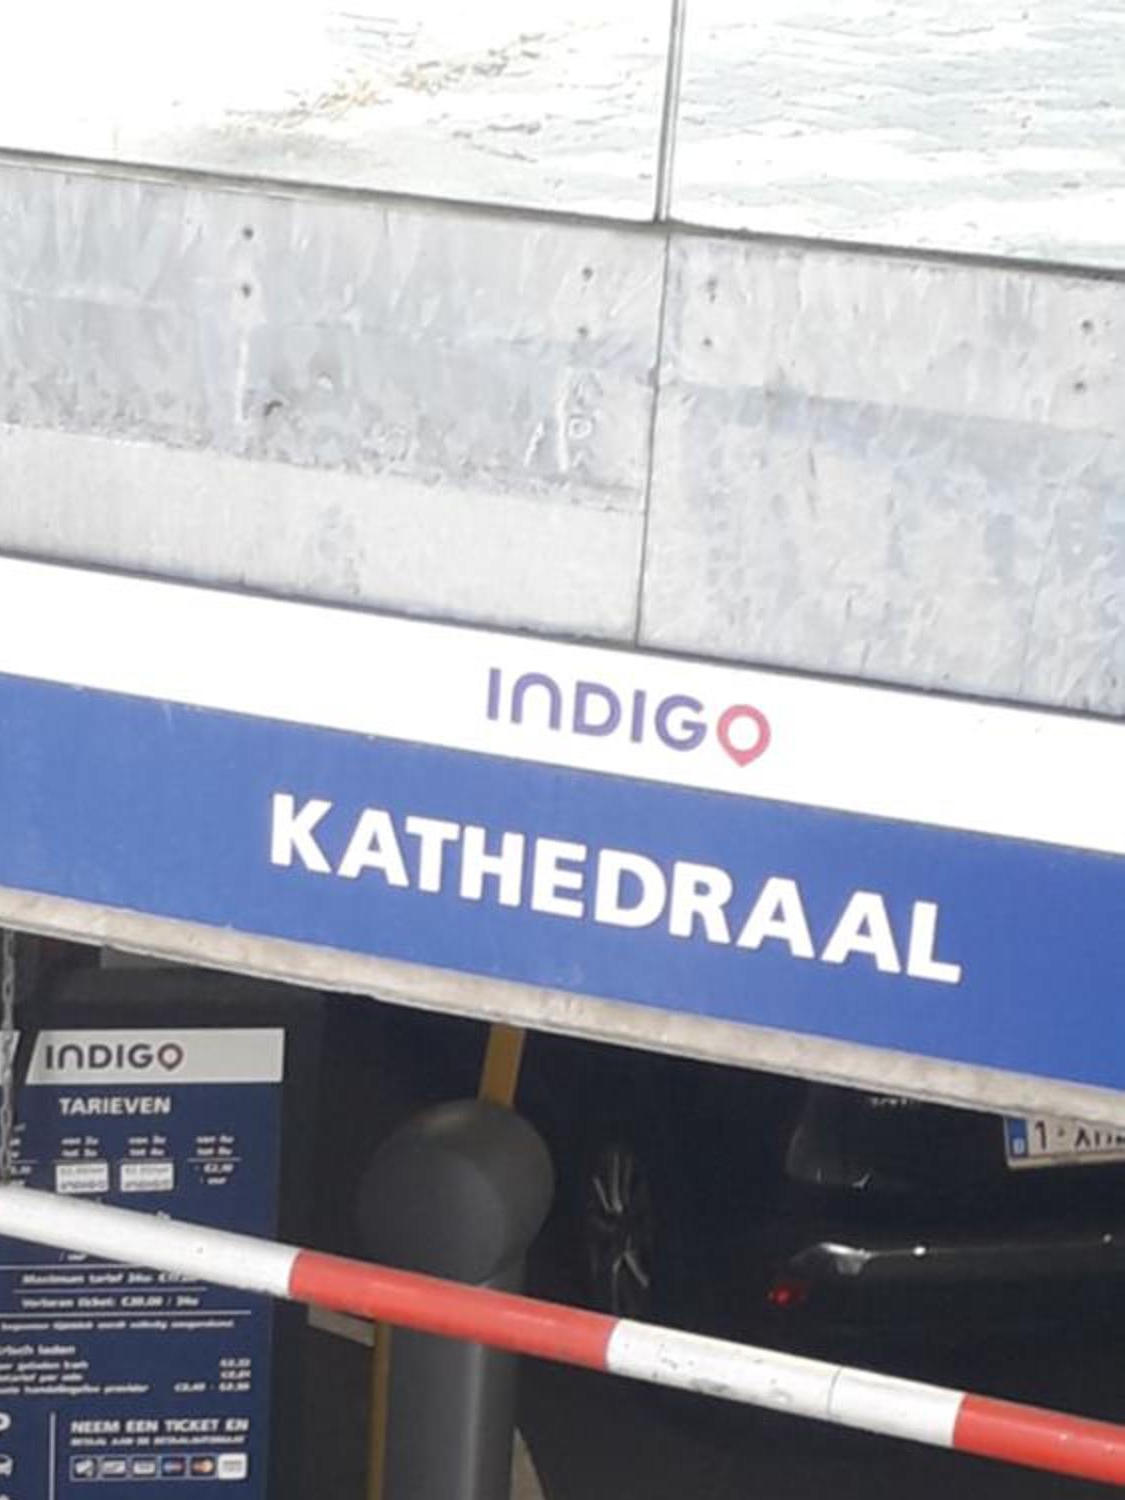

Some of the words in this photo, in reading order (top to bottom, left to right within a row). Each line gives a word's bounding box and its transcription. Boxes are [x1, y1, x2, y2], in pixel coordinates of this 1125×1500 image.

[485, 667, 771, 767] INDIGO
[270, 793, 963, 984] KATHEDRAAL
[46, 1043, 183, 1071] INDIGO
[59, 1097, 171, 1115] TARIEVEN
[71, 1420, 121, 1434] NEEM
[126, 1419, 159, 1433] EEN
[164, 1418, 220, 1432] TICKET
[225, 1418, 249, 1431] EN
